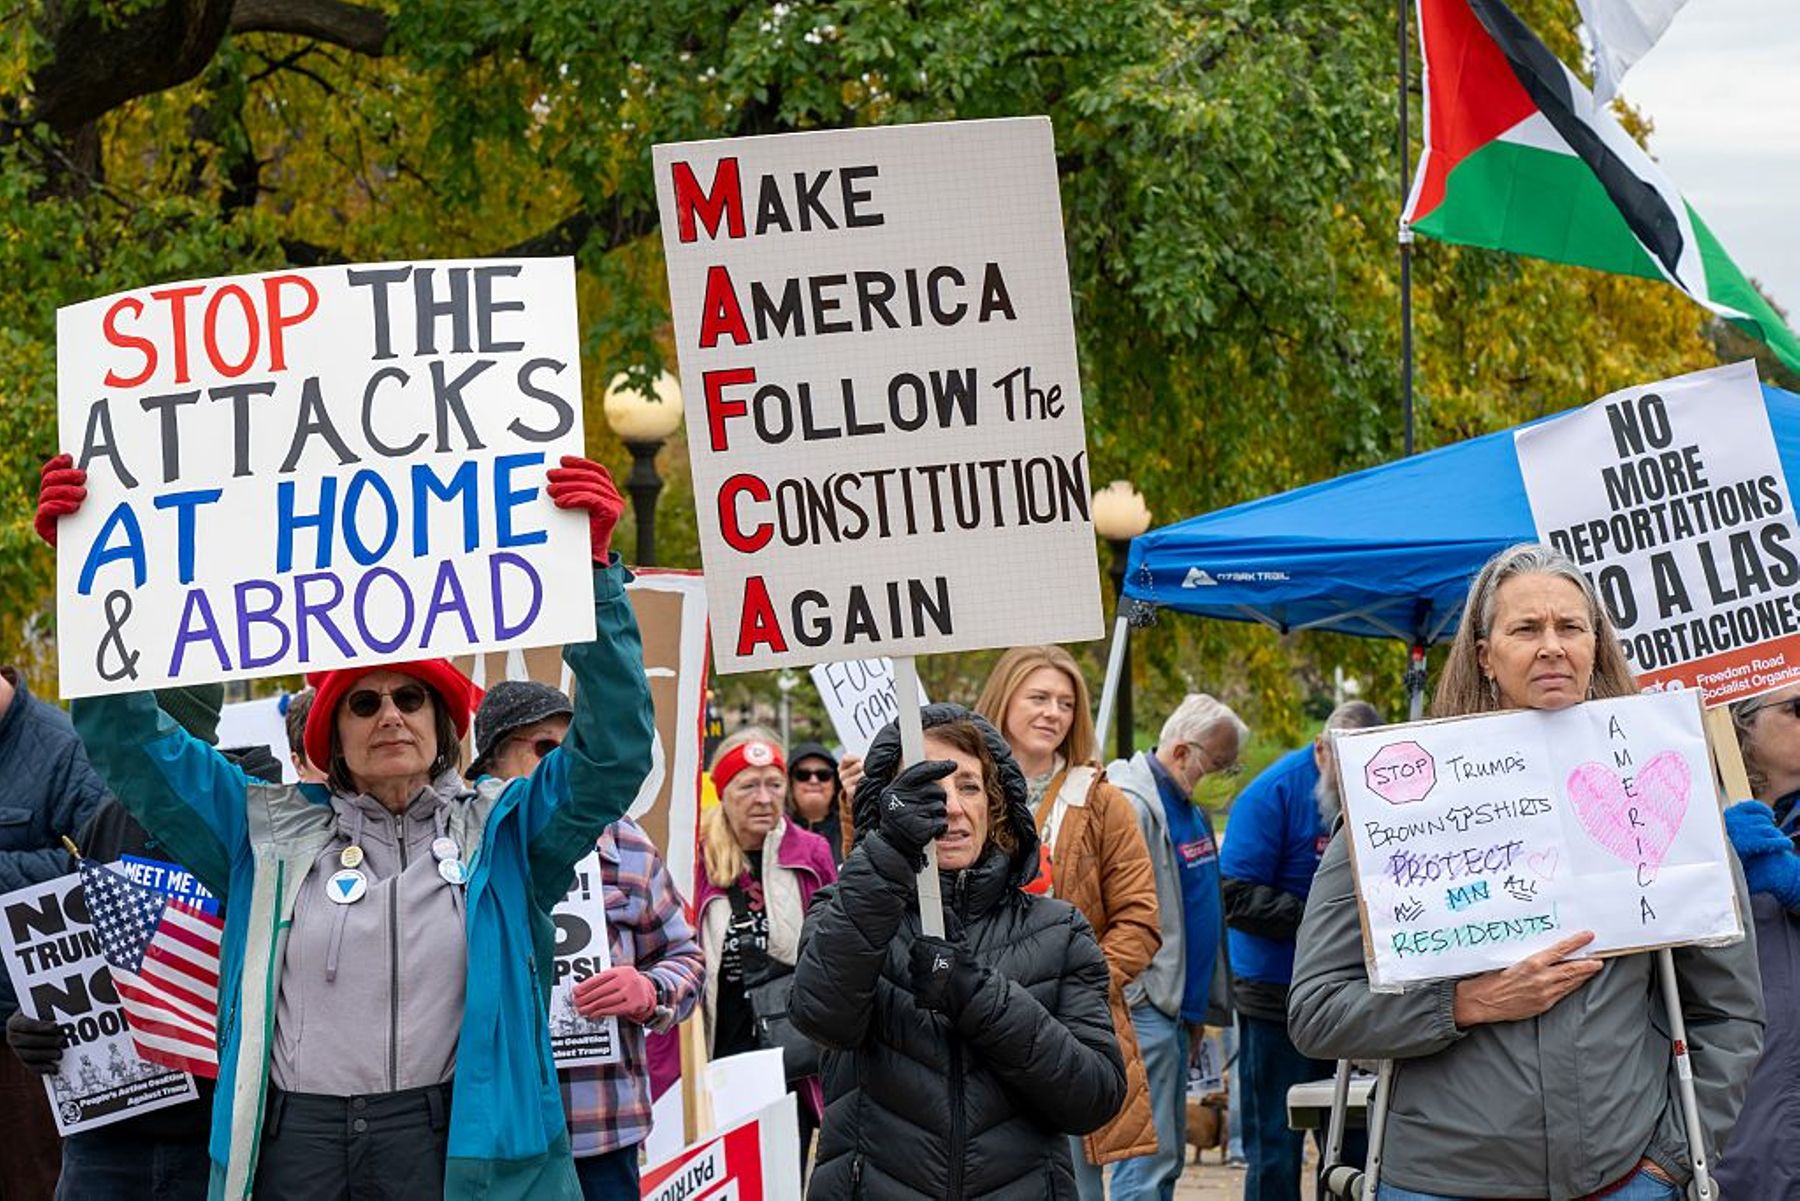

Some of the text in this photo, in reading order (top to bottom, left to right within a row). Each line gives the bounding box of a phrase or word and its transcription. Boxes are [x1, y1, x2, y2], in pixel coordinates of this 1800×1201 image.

[671, 157, 884, 243] MAKE
[103, 265, 525, 388] STOP THE
[699, 262, 1017, 348] AMERICA
[79, 358, 574, 489] ATTACKS
[702, 366, 1065, 452] FOLLOW The
[1605, 394, 1673, 459] NO
[718, 450, 1090, 553] CONSTITUTION
[1602, 445, 1708, 511] MORE
[77, 452, 548, 595] AT HOME
[1549, 475, 1783, 565] DEPORTATIONS
[96, 552, 543, 681] & ABROAD
[735, 576, 954, 656] AGAIN
[1585, 523, 1799, 629] O A LAS
[1696, 653, 1785, 686] Freedom Road
[1702, 678, 1751, 700] Socialist
[1752, 665, 1800, 688] Organiz
[1373, 758, 1427, 785] STOP
[1364, 817, 1445, 849] BROWN
[1475, 798, 1552, 824] SHIRTS
[1391, 840, 1523, 886] PROTECT
[124, 862, 165, 888] MEET
[167, 870, 194, 893] ME
[1447, 881, 1490, 910] MN
